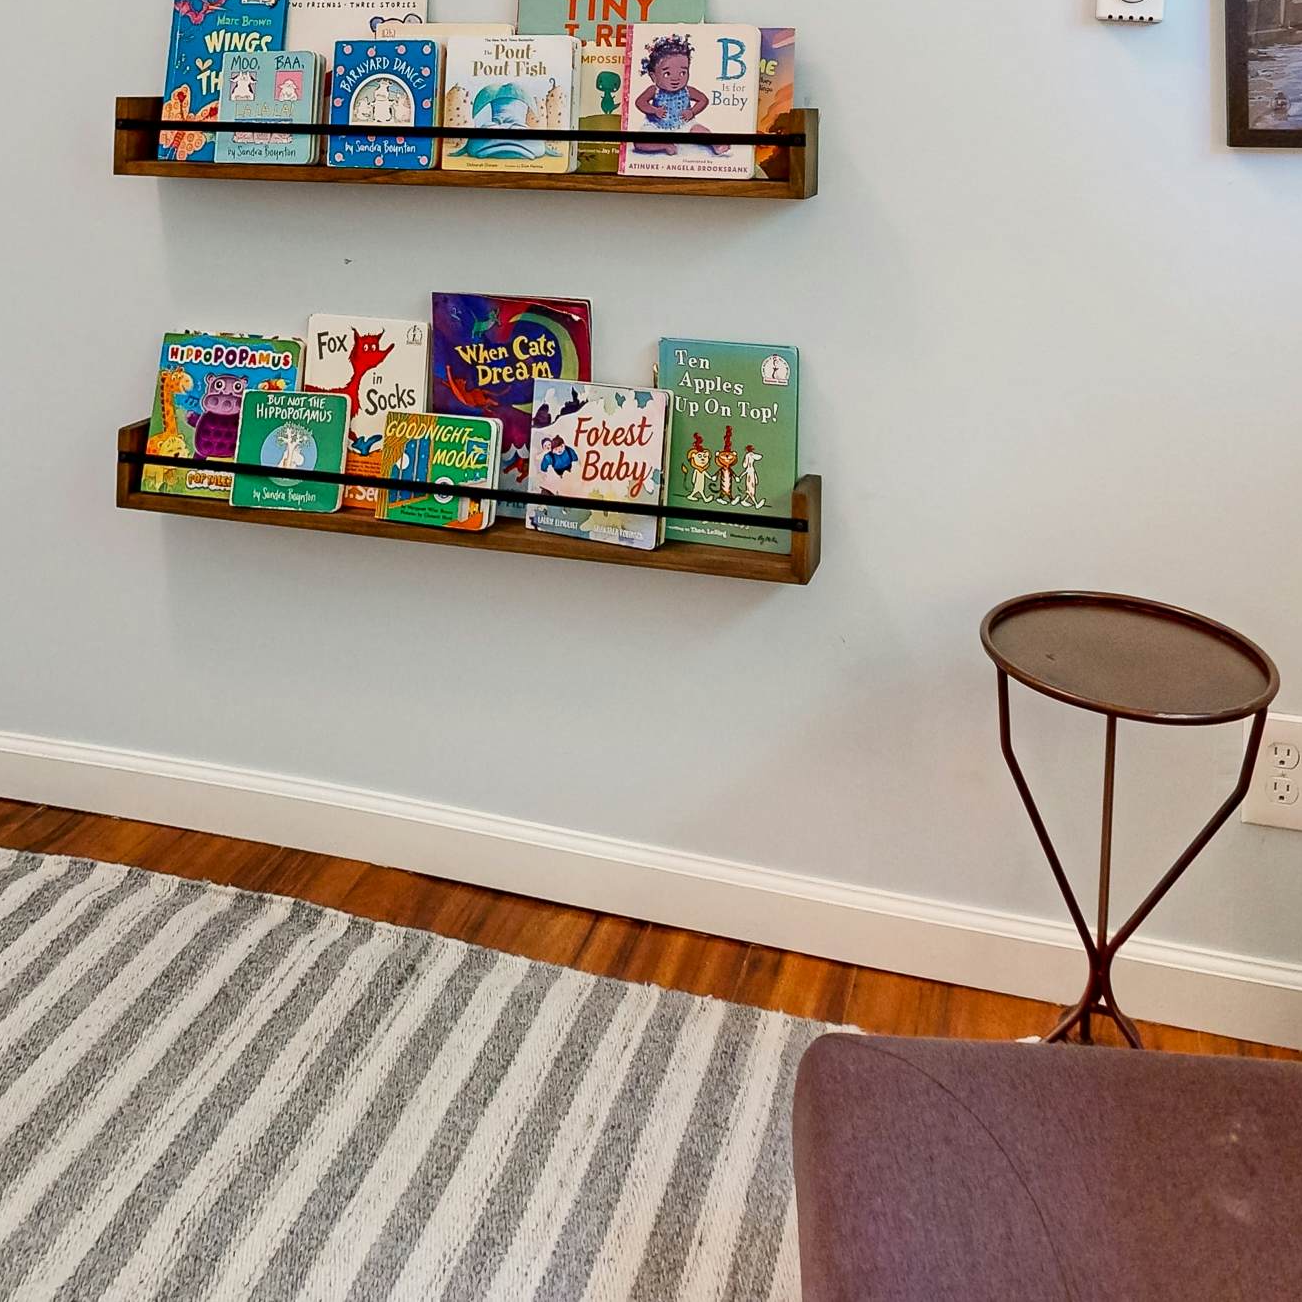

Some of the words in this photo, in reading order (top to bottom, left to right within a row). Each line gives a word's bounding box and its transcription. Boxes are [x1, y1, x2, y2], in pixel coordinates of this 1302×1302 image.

[350, 1, 375, 9] THREE
[380, 1, 417, 9] STORIES
[217, 15, 239, 26] Marc
[241, 15, 272, 27] Brown
[204, 29, 272, 54] WINGS
[494, 44, 537, 59] Pout-
[274, 55, 305, 69] BAA,
[472, 60, 509, 76] Pout
[515, 60, 547, 77] Fish
[716, 38, 747, 81] B
[339, 57, 390, 93] BARNYARD
[393, 58, 427, 90] DANCE!
[722, 83, 731, 91] Is
[732, 83, 747, 92] for
[711, 90, 748, 111] Baby
[227, 148, 236, 159] by
[237, 145, 262, 157] Sandra
[264, 146, 296, 160] Boynton
[344, 141, 354, 155] by
[355, 139, 382, 153] Sandra
[383, 140, 416, 156] Boynton
[666, 164, 695, 172] ANGELA
[317, 331, 348, 360] Fox
[454, 344, 509, 365] When
[512, 334, 556, 360] Cats
[169, 346, 293, 369] HIPPOPOPAMUS
[675, 349, 710, 370] Ten
[372, 372, 383, 385] in
[476, 361, 554, 386] Dream
[679, 371, 744, 396] Apples
[267, 395, 285, 405] BUT
[287, 396, 306, 406] NOT
[309, 396, 326, 409] THE
[365, 383, 416, 415] Socks
[675, 396, 699, 417] Up
[704, 398, 732, 417] On
[738, 402, 779, 423] Top!
[256, 403, 333, 424] HIPPOPOTAMUS
[386, 420, 474, 444] GOODNIGHT
[573, 416, 654, 448] Forest
[432, 448, 478, 468] MOON
[581, 449, 653, 498] Baby
[253, 489, 261, 502] by
[262, 488, 286, 501] Sandra
[287, 488, 317, 503] Boynton
